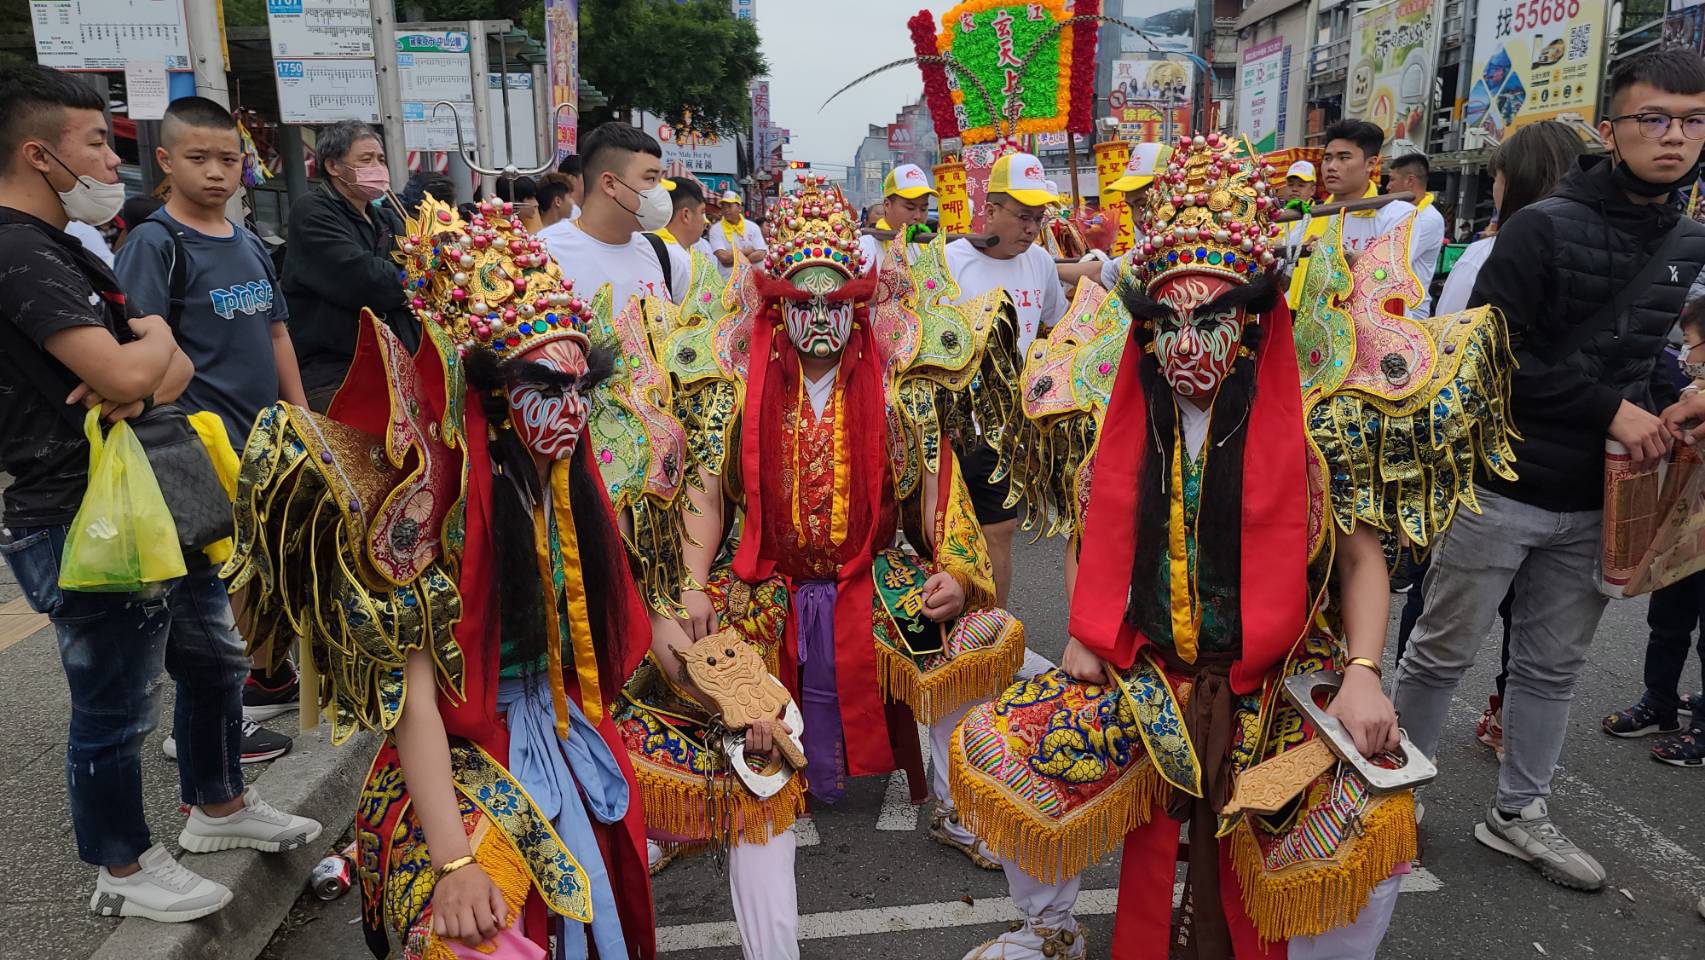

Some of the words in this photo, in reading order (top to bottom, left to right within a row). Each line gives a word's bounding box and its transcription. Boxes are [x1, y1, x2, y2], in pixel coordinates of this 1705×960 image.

[1027, 3, 1044, 20] 江
[960, 12, 977, 32] 家
[278, 63, 303, 73] 1750
